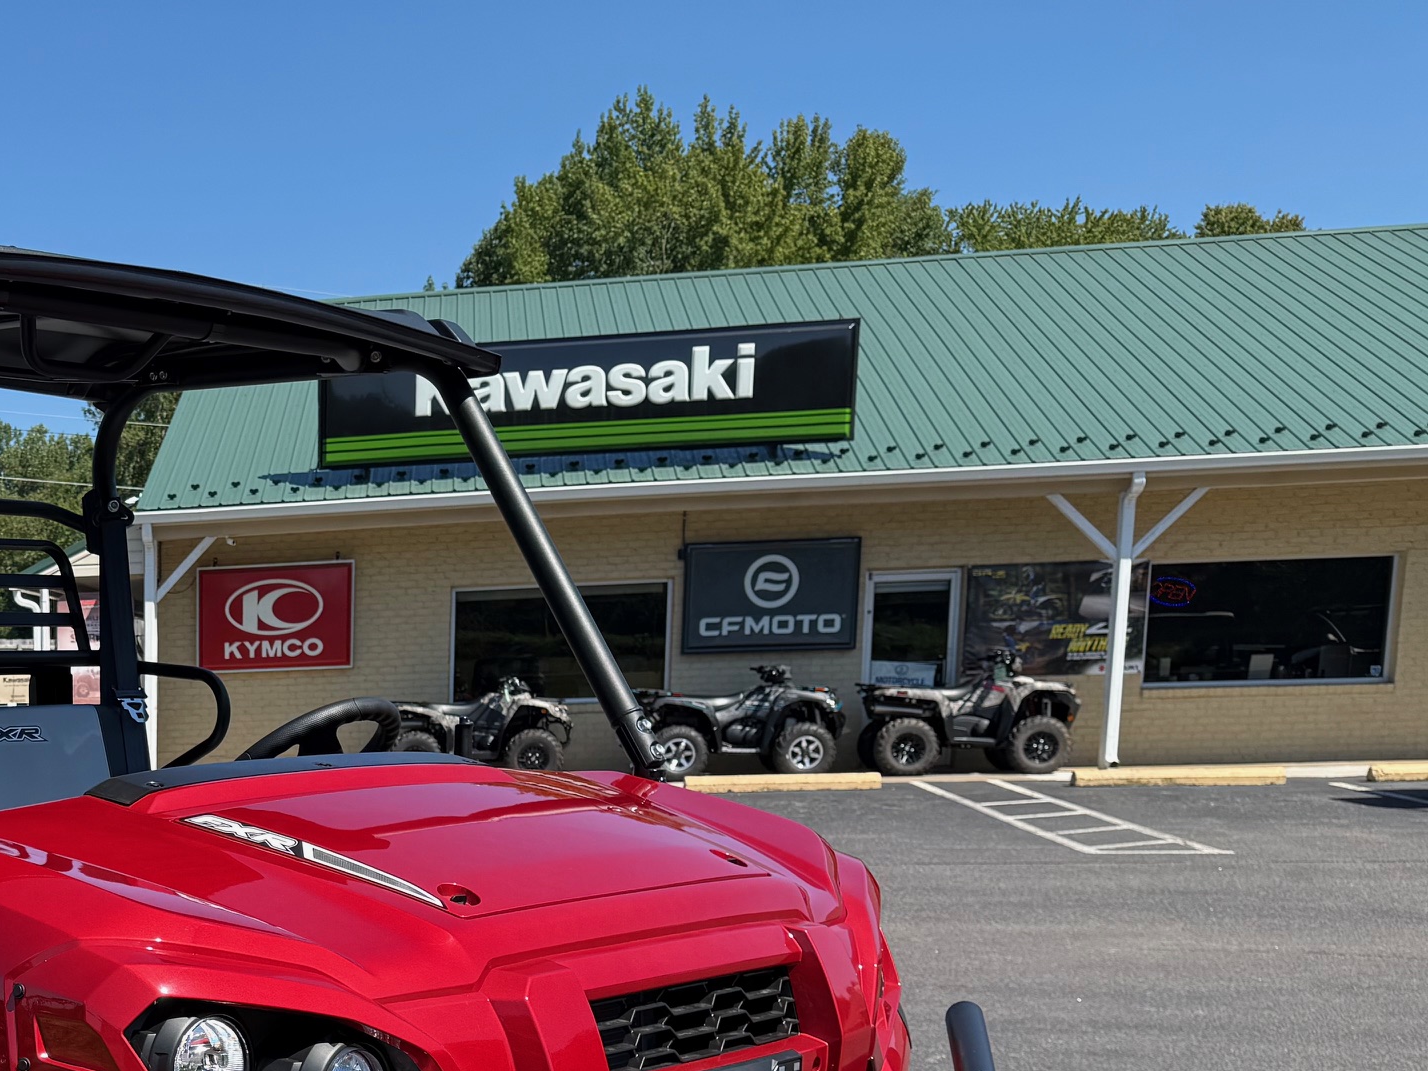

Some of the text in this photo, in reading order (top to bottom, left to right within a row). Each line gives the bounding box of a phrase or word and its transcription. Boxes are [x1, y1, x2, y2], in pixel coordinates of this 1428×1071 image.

[699, 613, 842, 637] CFMOTO
[224, 637, 324, 660] KYMCO
[1067, 637, 1112, 653] ANYTH
[183, 813, 300, 856] FXR
